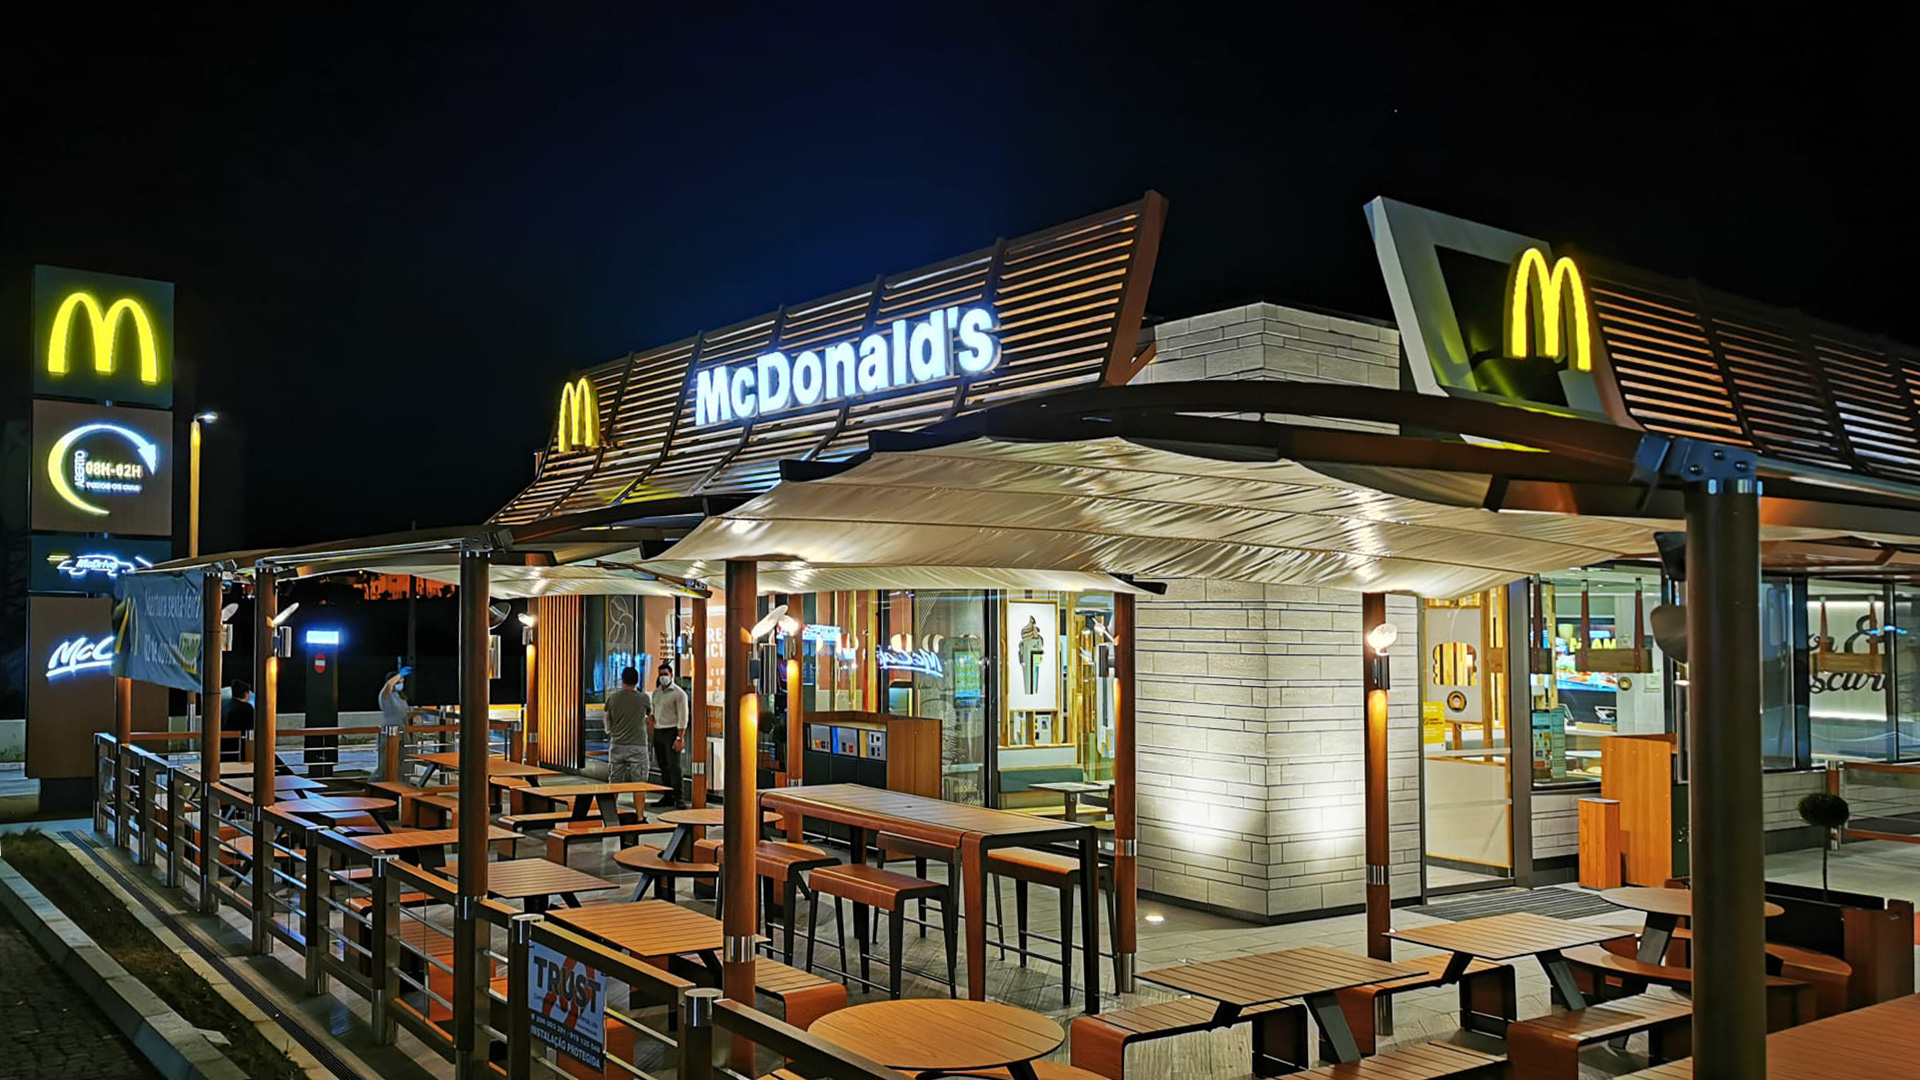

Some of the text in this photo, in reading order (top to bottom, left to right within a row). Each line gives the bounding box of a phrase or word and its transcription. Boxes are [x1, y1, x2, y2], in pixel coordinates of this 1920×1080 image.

[695, 306, 998, 426] McDonald's
[74, 450, 87, 488] ABERTO
[76, 559, 118, 570] McDrive
[533, 956, 601, 1013] TRUST
[567, 1042, 601, 1068] PROTEGIDA
